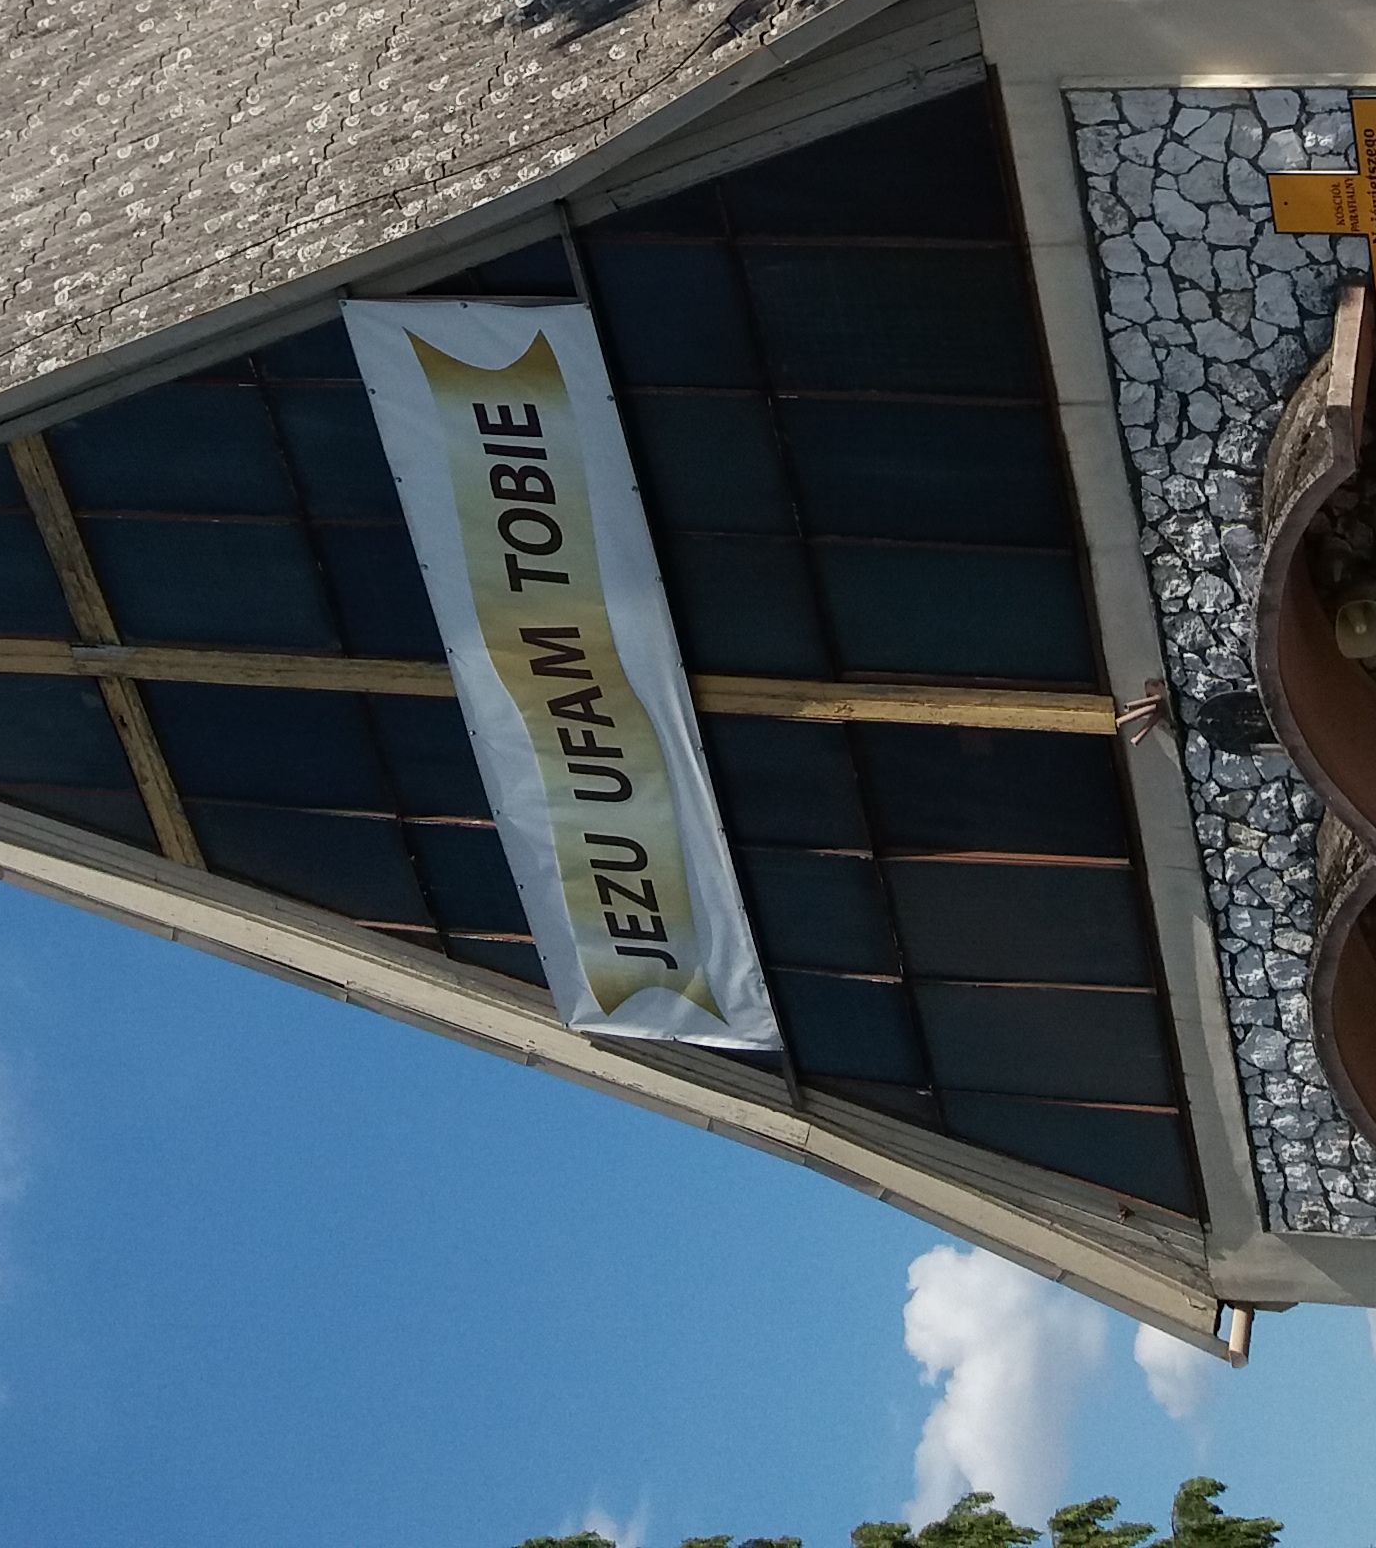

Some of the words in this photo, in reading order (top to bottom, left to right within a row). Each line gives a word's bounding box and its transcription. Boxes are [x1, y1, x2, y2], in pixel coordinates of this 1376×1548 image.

[1344, 178, 1360, 232] PARAFIALNY
[472, 403, 569, 592] TOBIE
[519, 626, 632, 803] UFAM
[585, 832, 677, 970] JEZU
